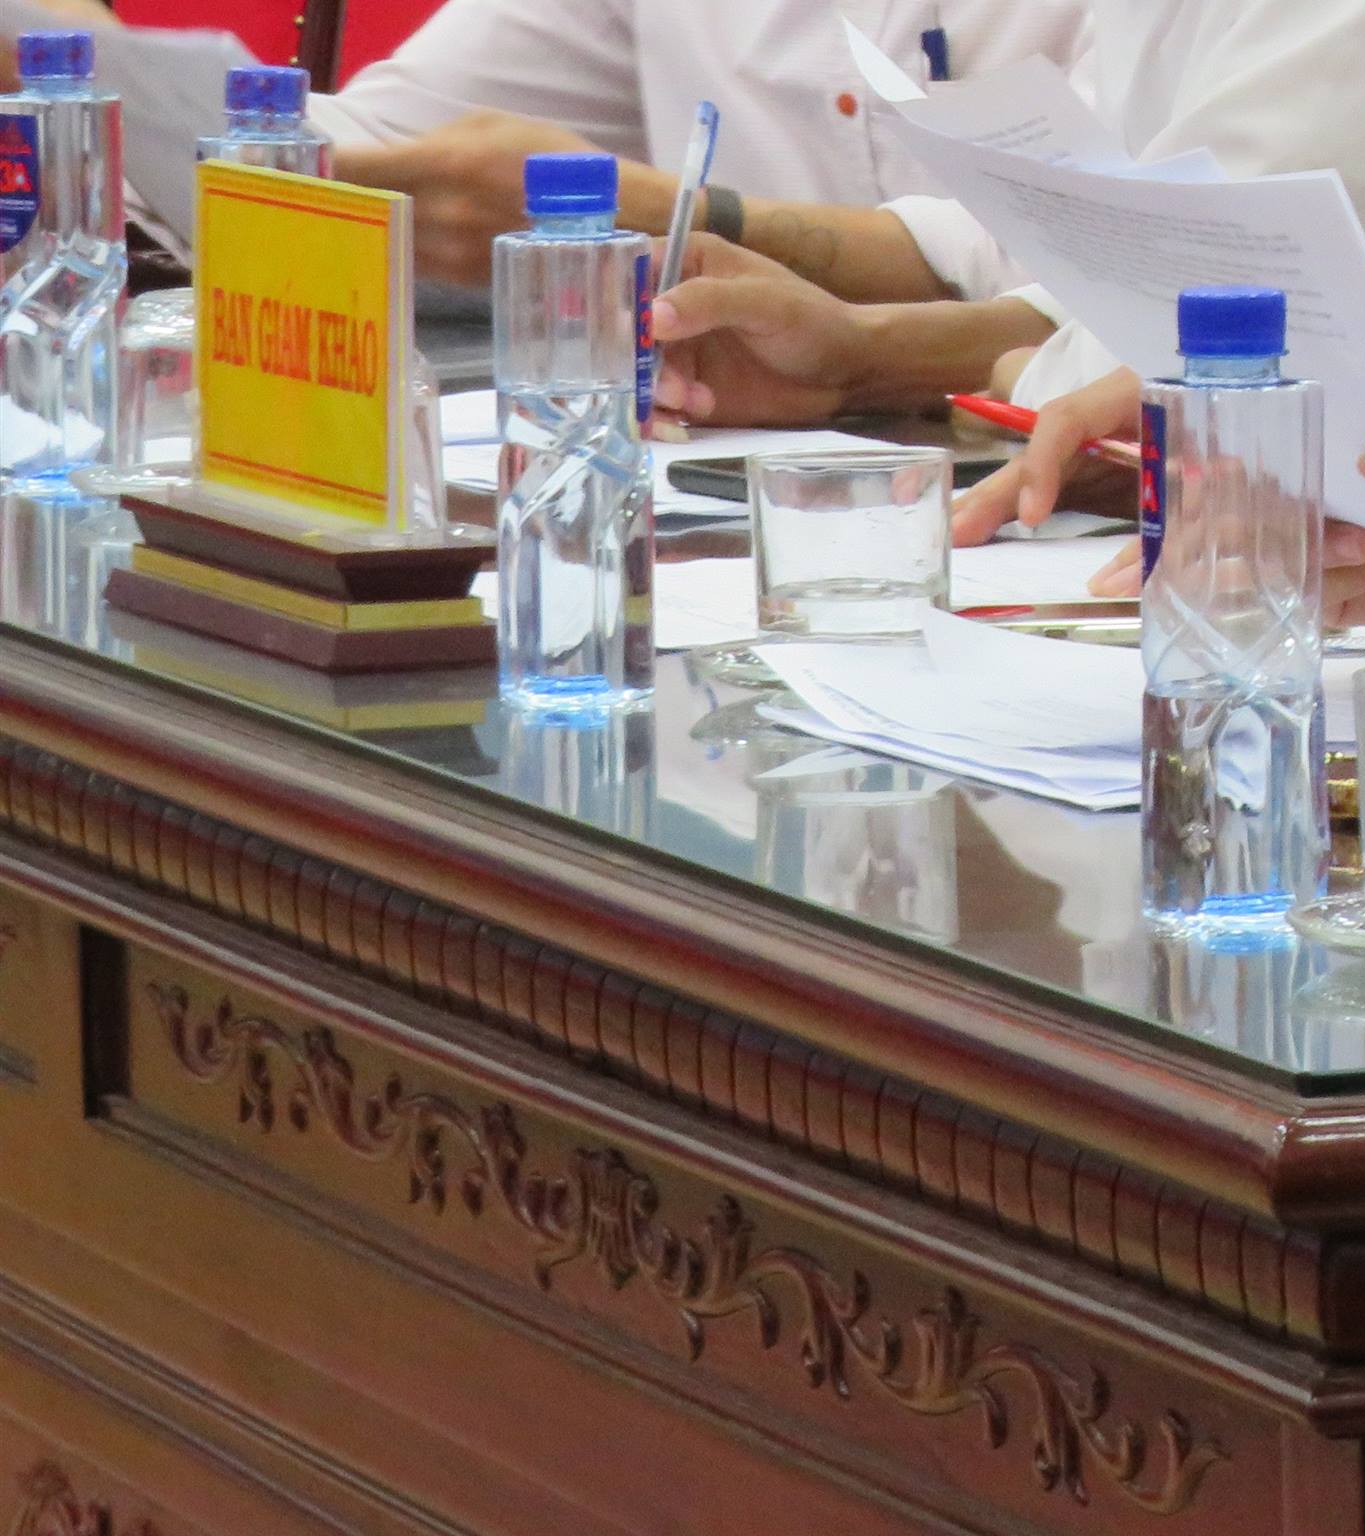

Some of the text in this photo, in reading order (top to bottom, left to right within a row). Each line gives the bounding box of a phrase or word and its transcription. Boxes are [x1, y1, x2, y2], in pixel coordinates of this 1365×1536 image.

[213, 278, 378, 396] BAN GIÁM KHẢO
